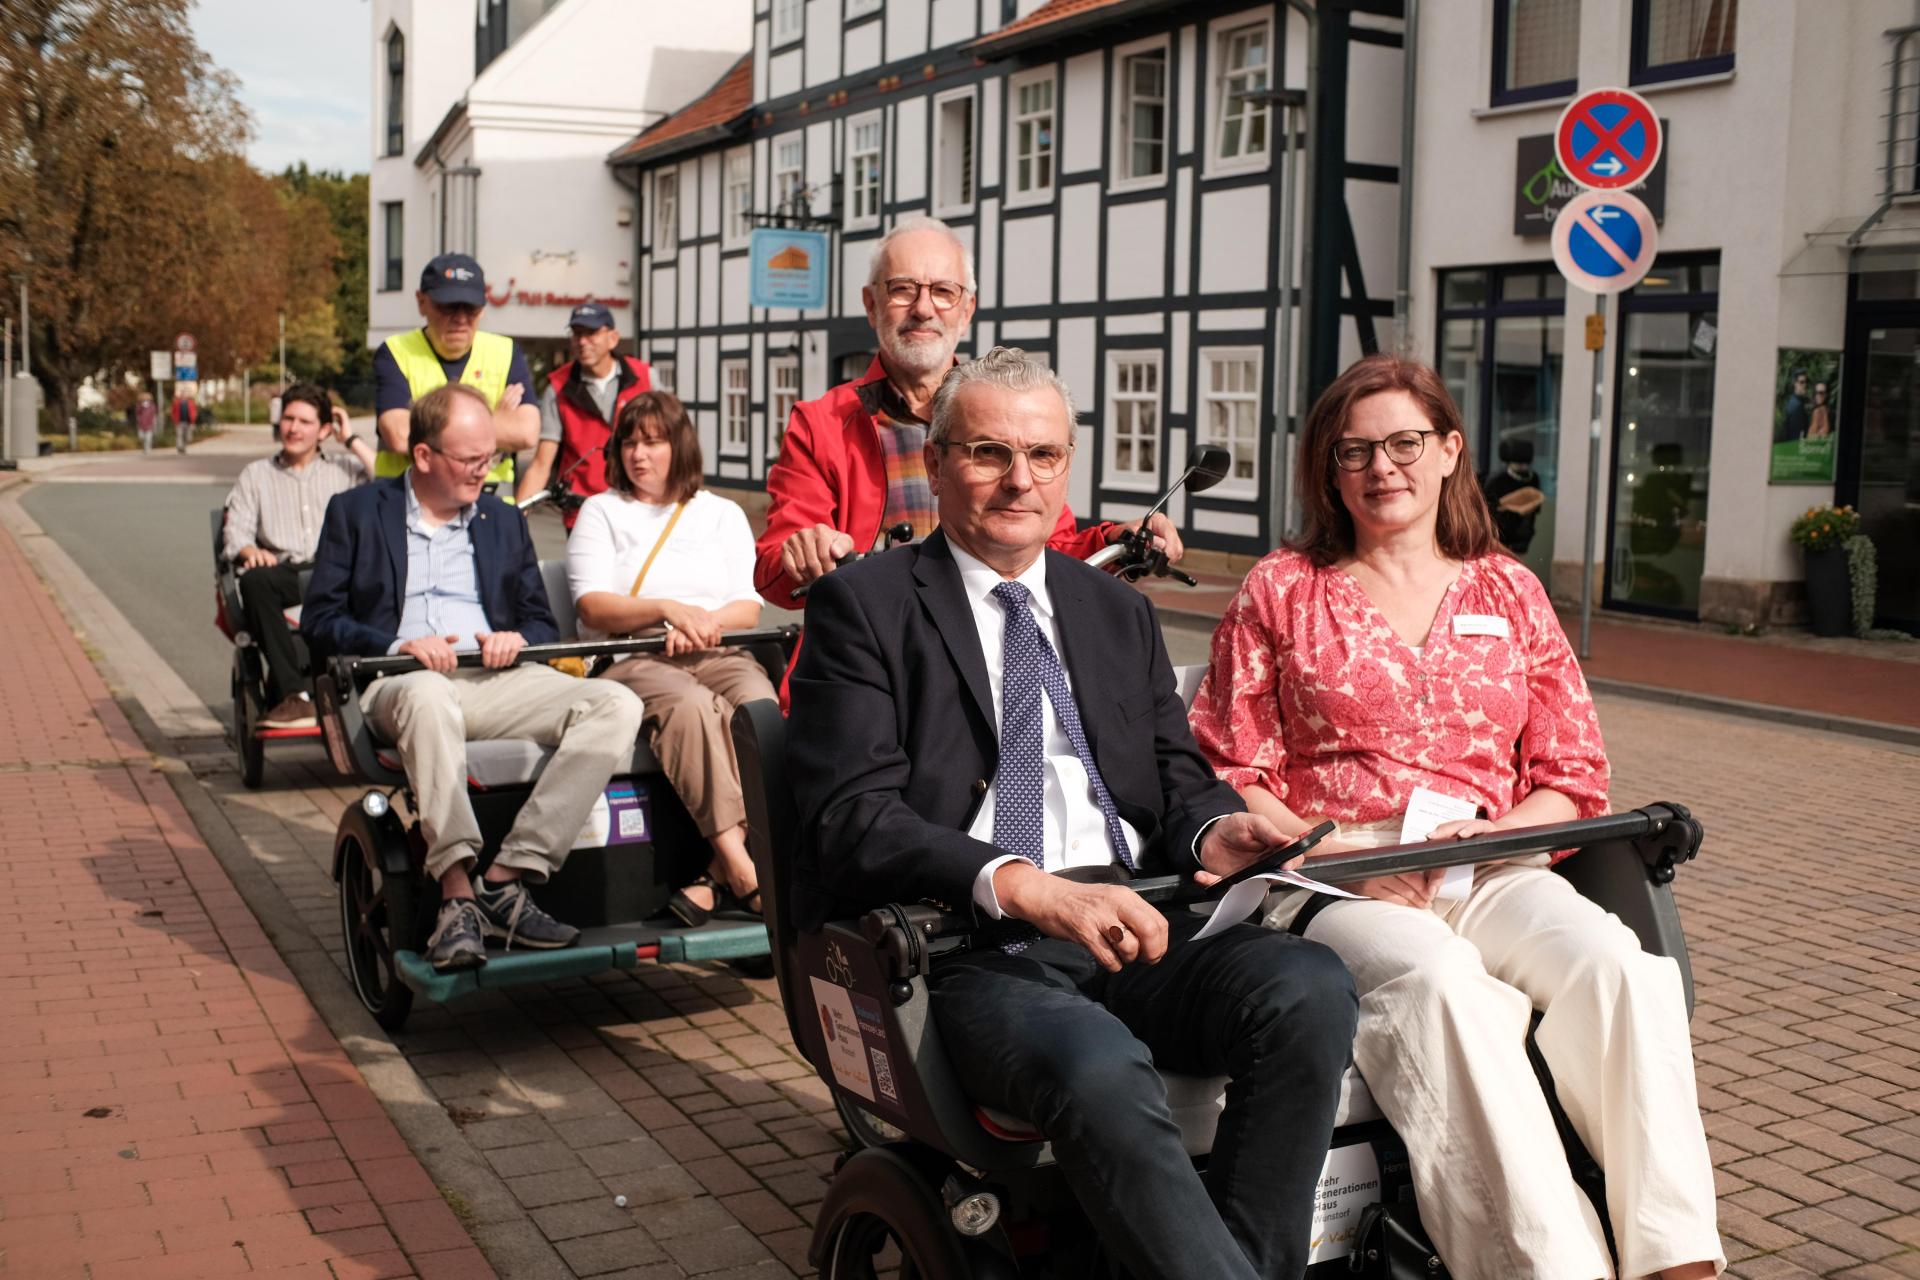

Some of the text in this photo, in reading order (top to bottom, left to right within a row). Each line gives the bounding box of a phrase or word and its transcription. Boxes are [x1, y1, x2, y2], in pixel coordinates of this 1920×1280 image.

[1317, 1176, 1340, 1188] Mehr
[1315, 1180, 1378, 1200] Generationen
[1314, 1200, 1338, 1212] Haus
[1314, 1208, 1351, 1223] Wunstorf
